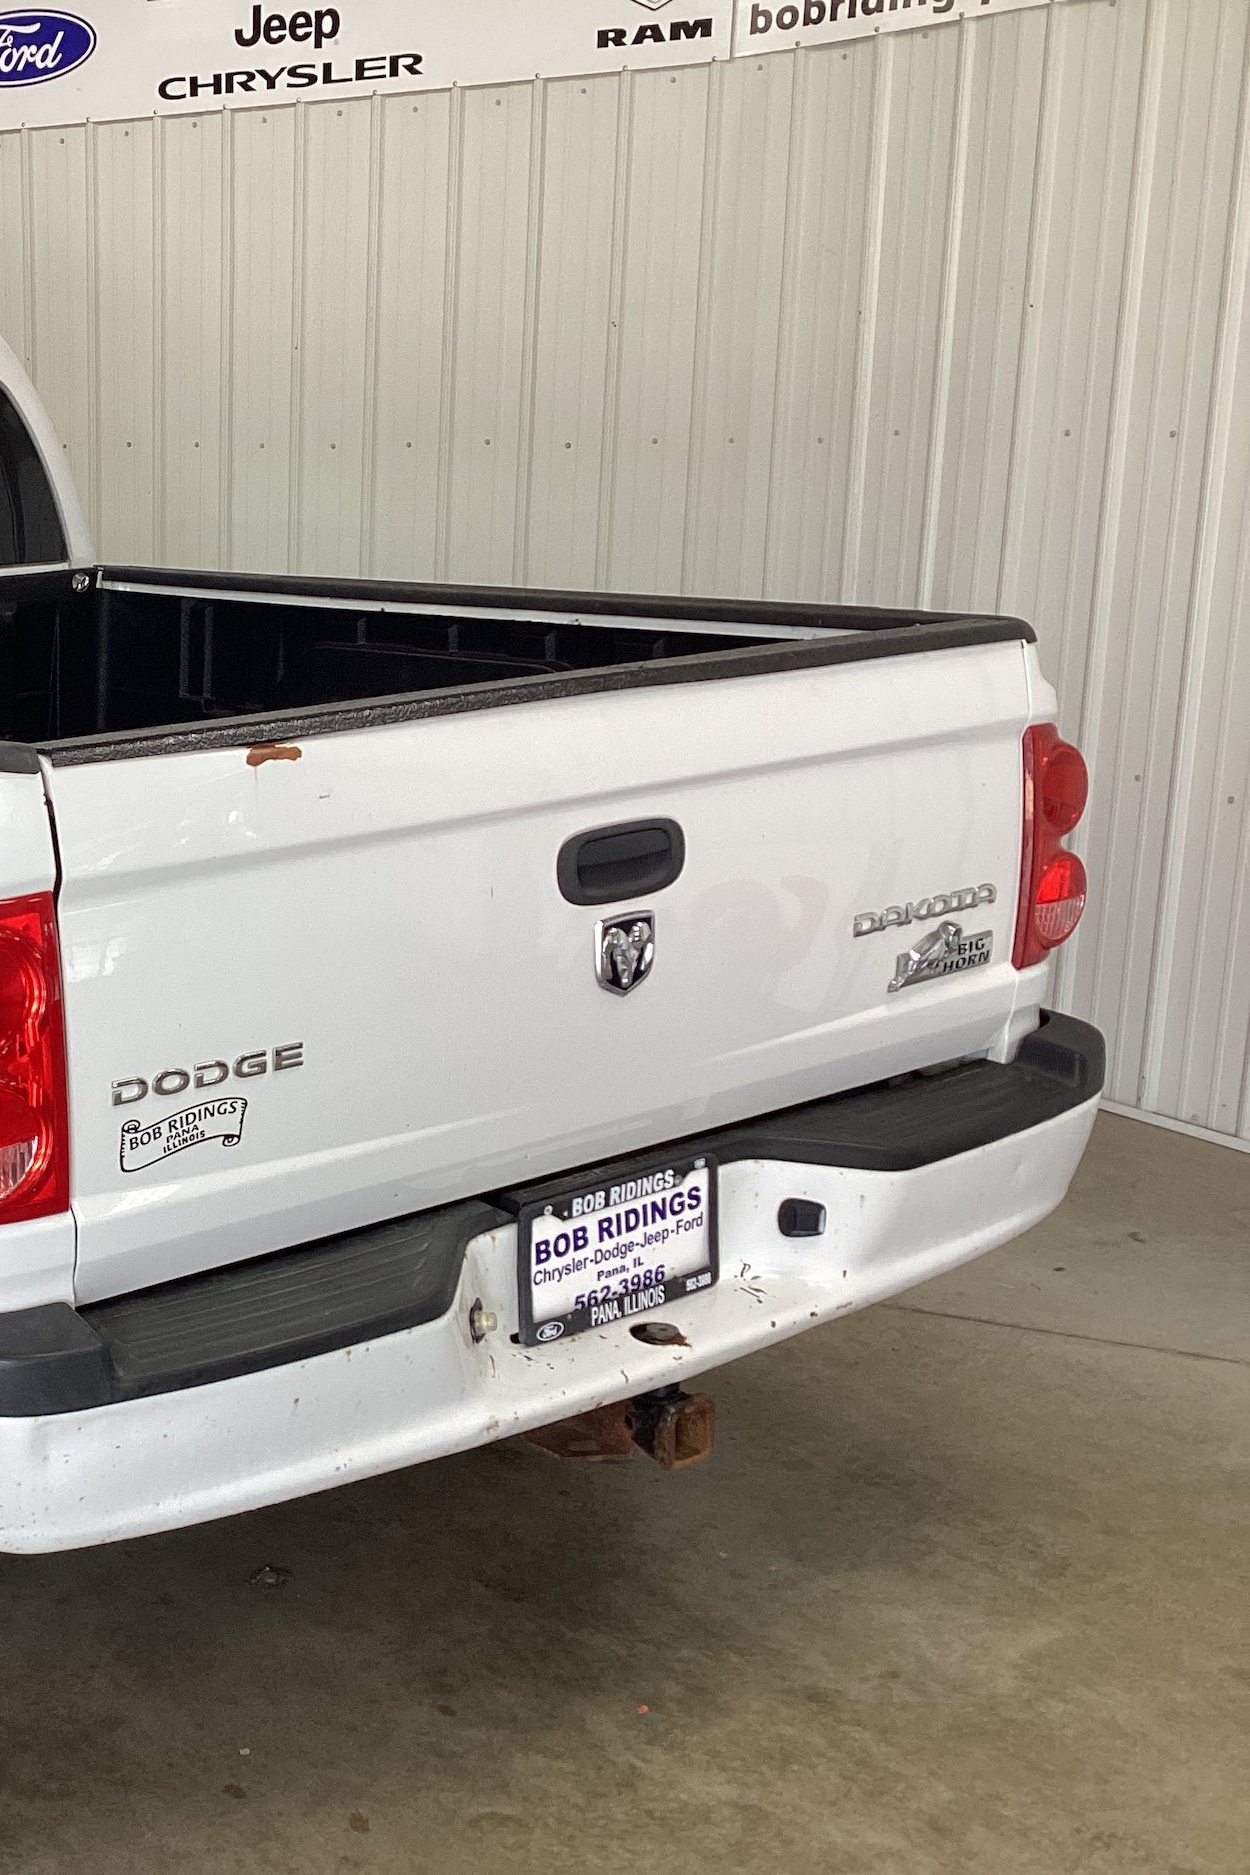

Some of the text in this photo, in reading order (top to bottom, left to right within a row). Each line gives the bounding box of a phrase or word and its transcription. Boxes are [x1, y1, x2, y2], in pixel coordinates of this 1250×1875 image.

[234, 5, 341, 48] Jeep
[597, 18, 712, 48] RAM
[750, 0, 990, 35] bobri
[158, 53, 423, 100] CHRYSLER
[853, 883, 997, 938] DAKOTA
[943, 950, 991, 973] HORN
[957, 938, 985, 956] BIG
[111, 1041, 304, 1107] DODGE
[129, 1100, 238, 1151] BOB RIDINGS
[163, 1129, 206, 1154] ILLINOIS
[166, 1124, 199, 1144] PANA
[571, 1169, 675, 1217] BOB RIDINGS
[534, 1185, 702, 1266] BOB RIDINGS
[533, 1212, 703, 1286] Chrysler-Dodge-Jeep-Ford
[597, 1256, 644, 1282] Pana, IL
[574, 1264, 666, 1310] 562-3986
[623, 1285, 666, 1316] ILLINOIS
